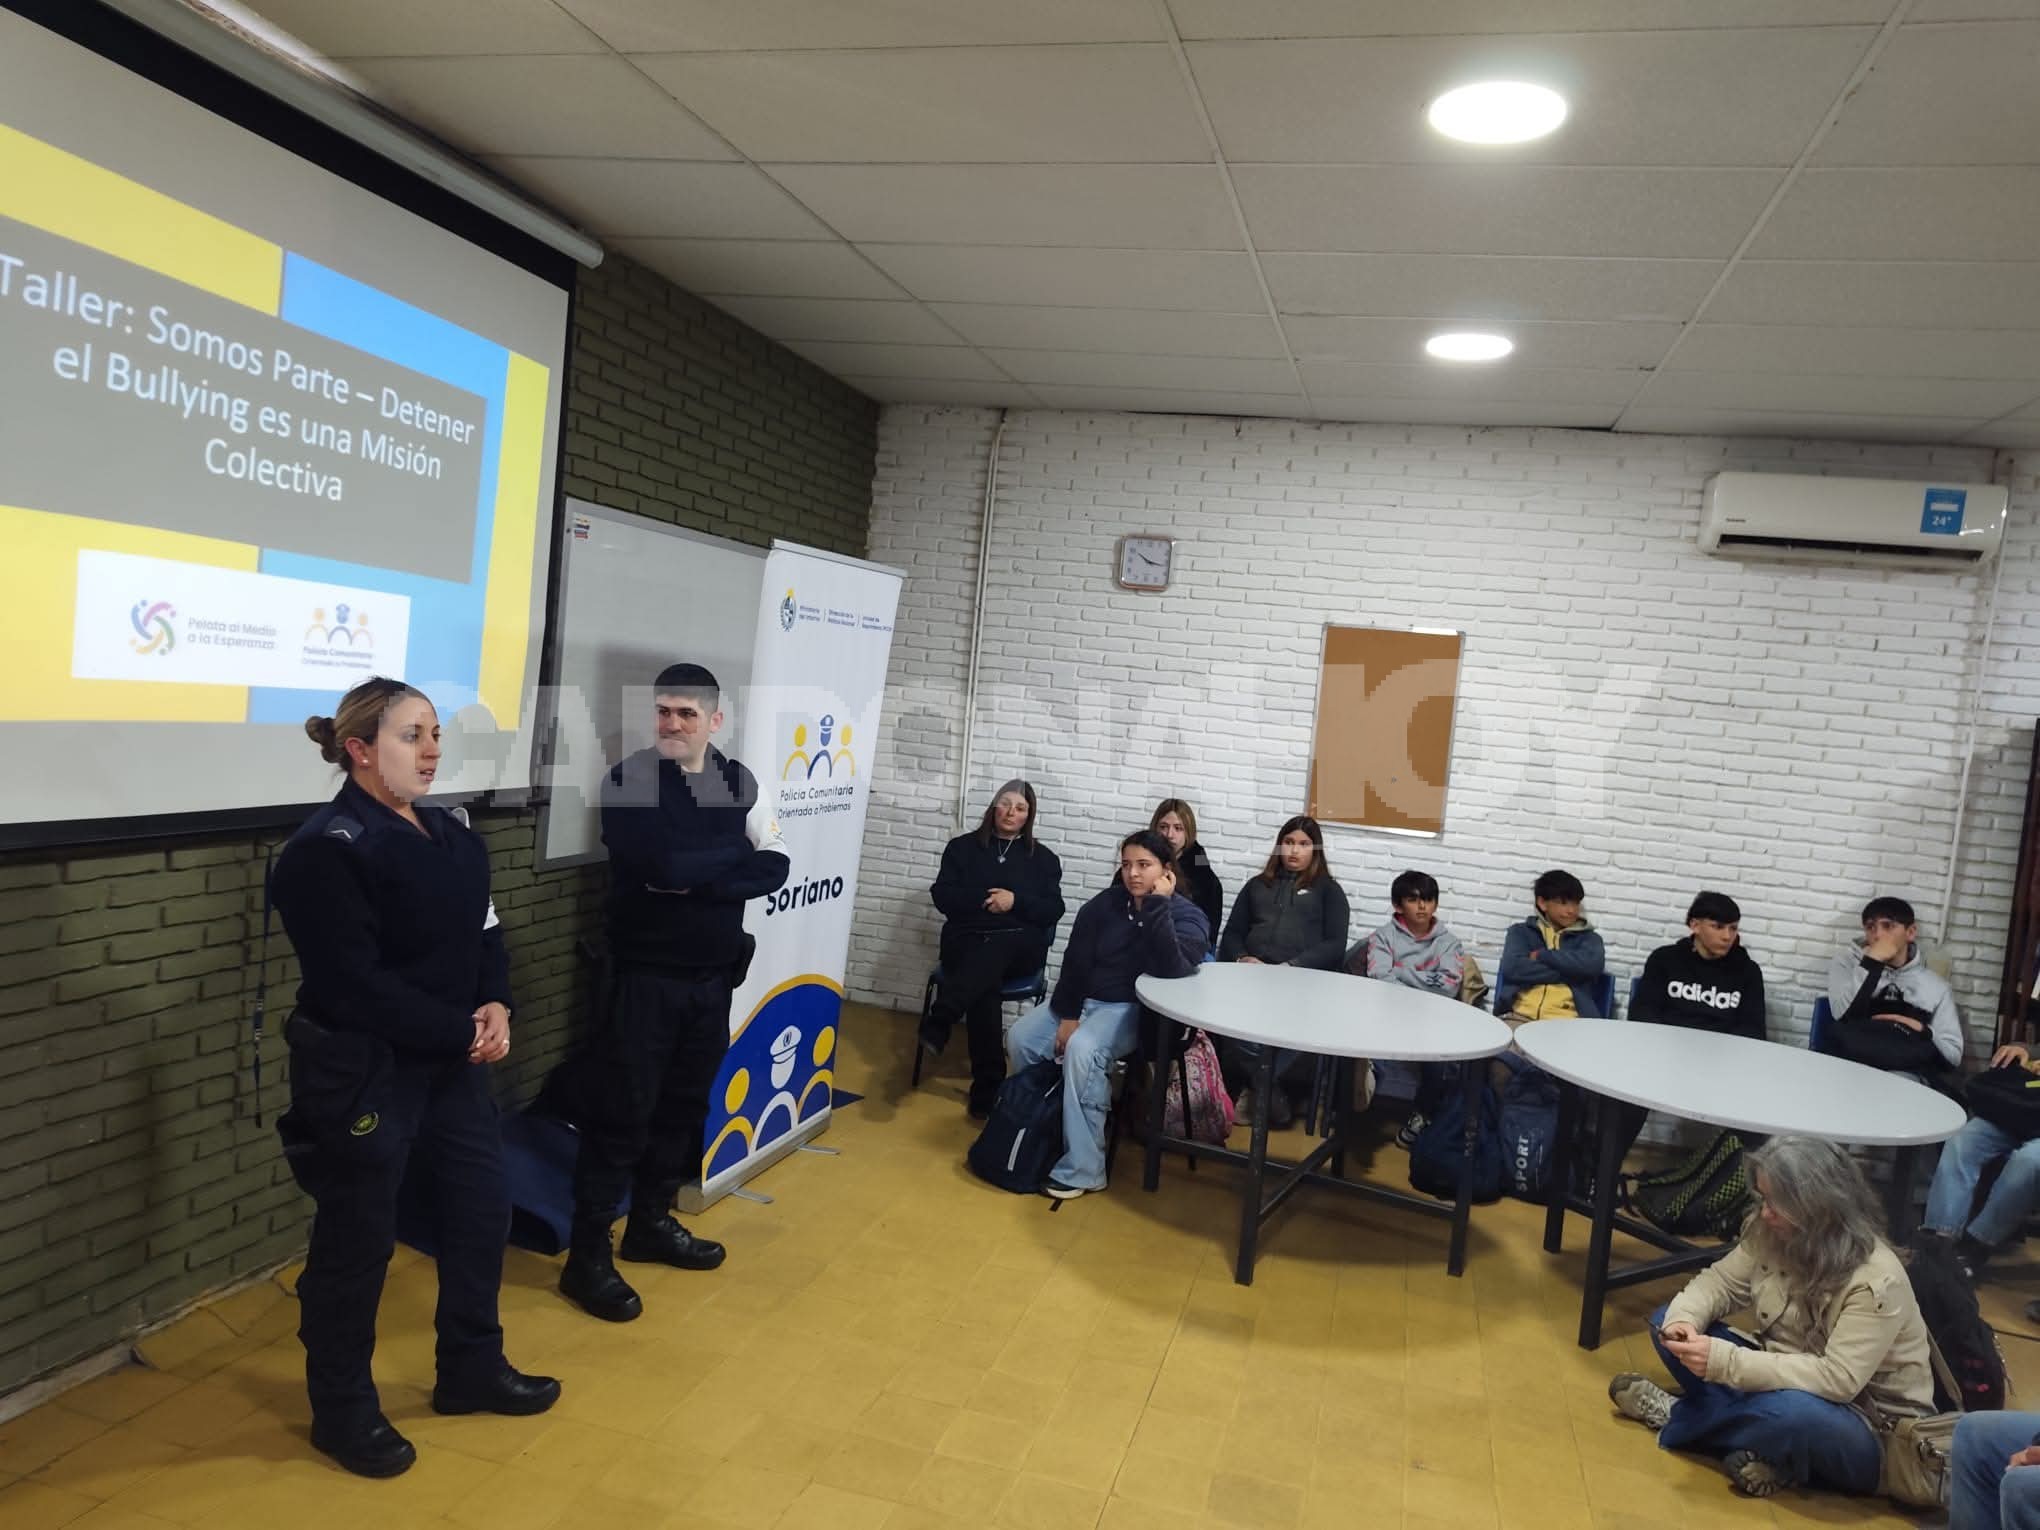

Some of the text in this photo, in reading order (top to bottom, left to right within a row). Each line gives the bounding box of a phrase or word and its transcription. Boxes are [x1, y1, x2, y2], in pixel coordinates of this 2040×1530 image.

[0, 253, 134, 334] Taller:
[146, 306, 263, 377] Somos
[273, 350, 350, 405] Parte
[380, 386, 475, 446] Detener
[53, 343, 442, 481] el Bullying es una Misión
[205, 438, 344, 502] Colectiva
[214, 633, 275, 651] Esperanza
[808, 783, 854, 800] Comunitaria
[819, 802, 851, 815] Problemas
[766, 876, 844, 917] Soriano
[1667, 980, 1742, 1009] adidas
[1514, 1135, 1530, 1193] SPORT
